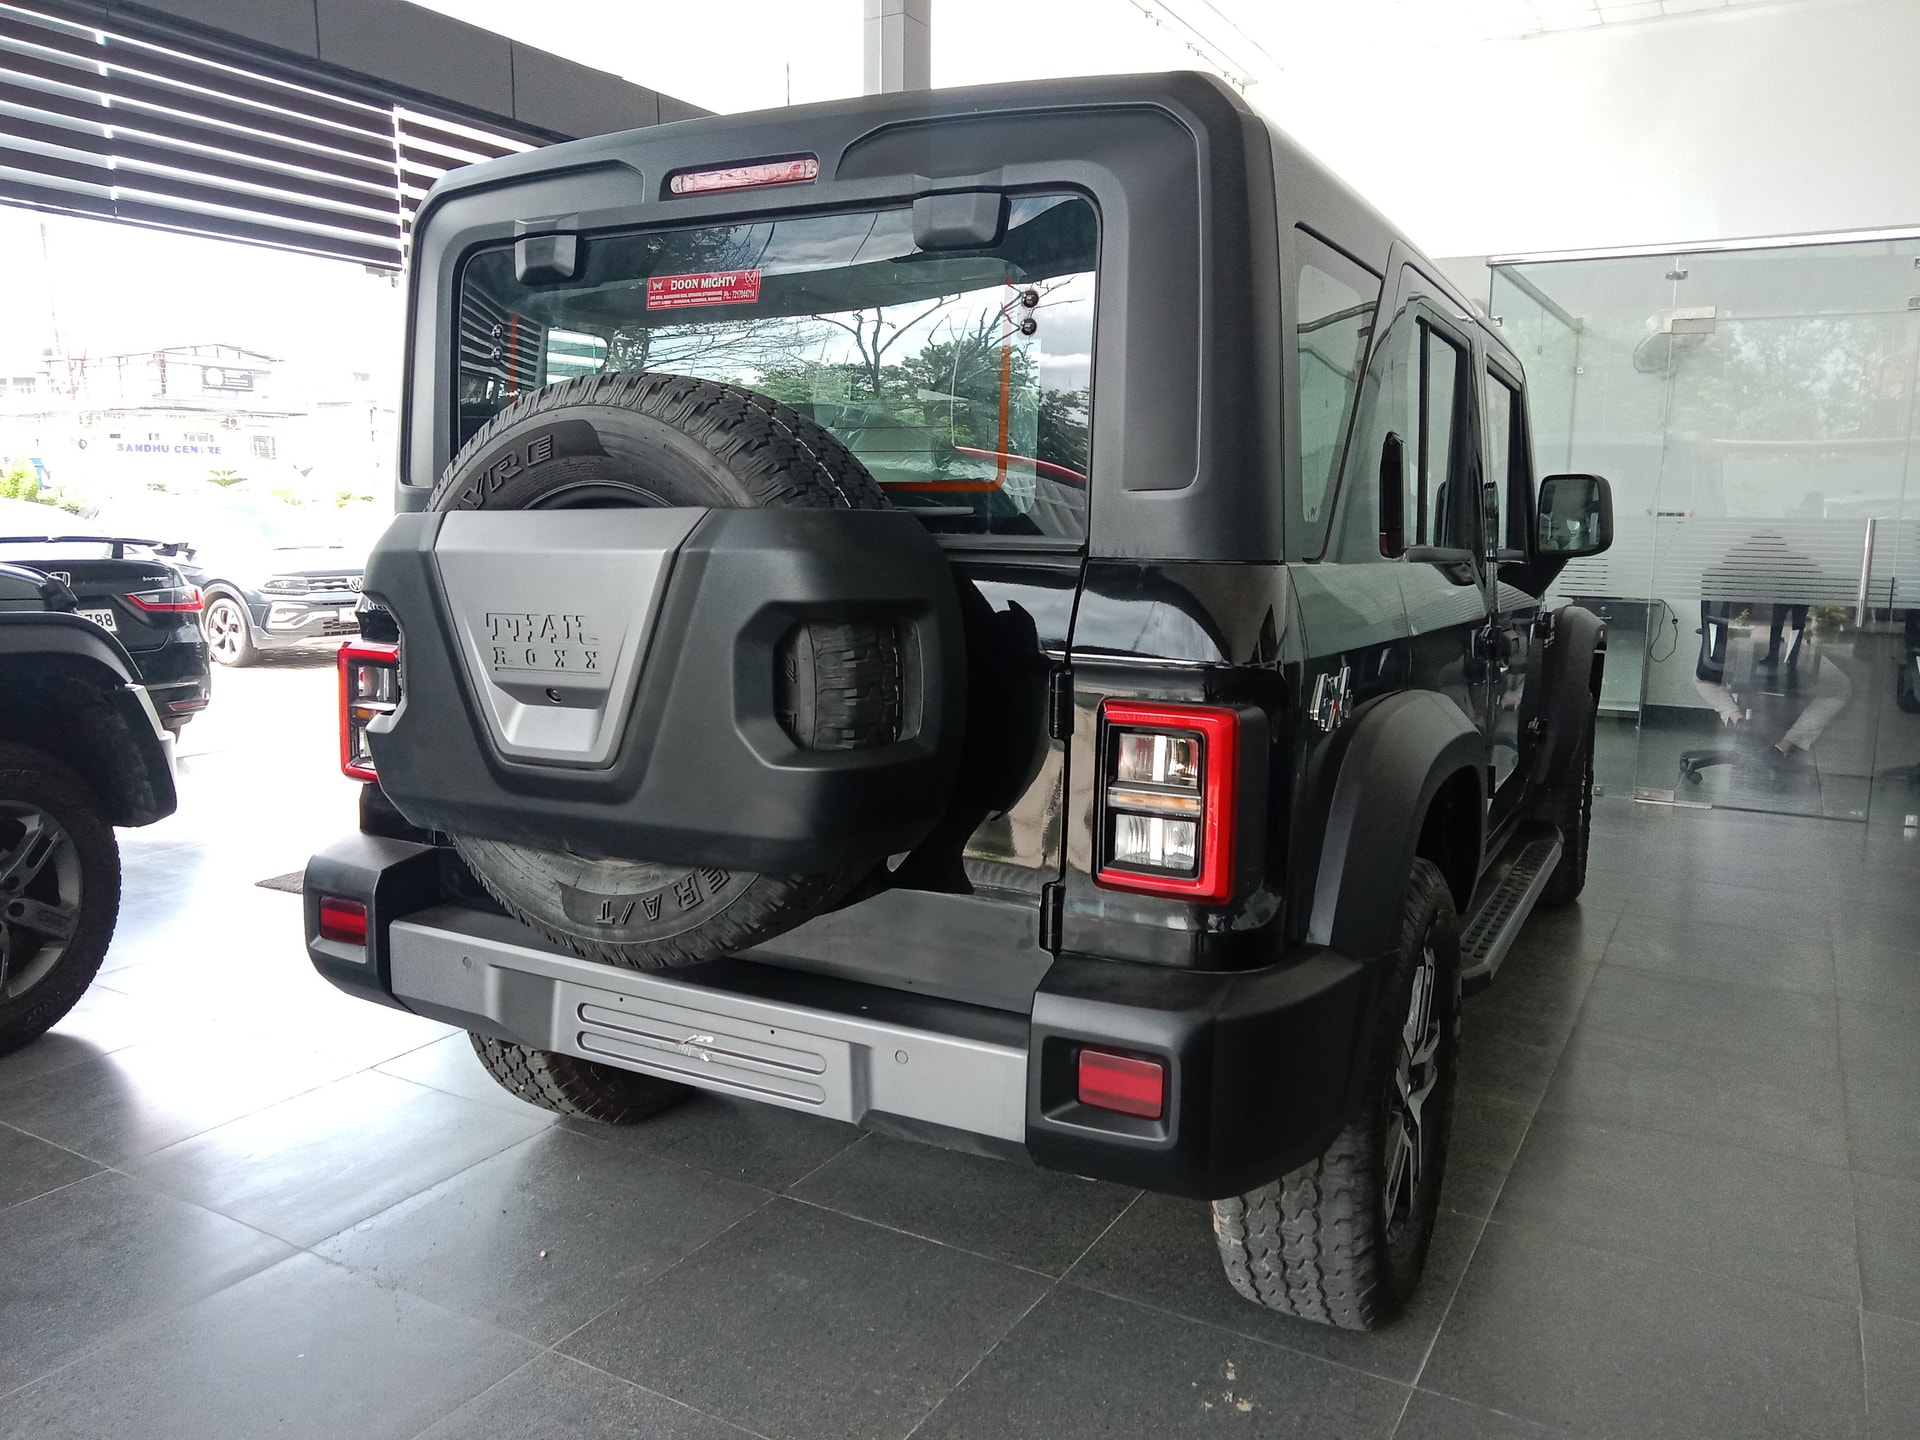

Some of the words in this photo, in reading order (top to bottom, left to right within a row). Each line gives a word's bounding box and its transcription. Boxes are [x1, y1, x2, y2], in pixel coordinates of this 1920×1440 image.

[670, 279, 699, 291] DOON
[701, 276, 737, 288] MIGHTY
[117, 443, 169, 453] SANDHU
[174, 445, 222, 455] CENRE
[457, 433, 554, 511] YRE
[493, 646, 602, 669] ROXX
[673, 865, 732, 912] ER
[595, 893, 663, 925] A/T
